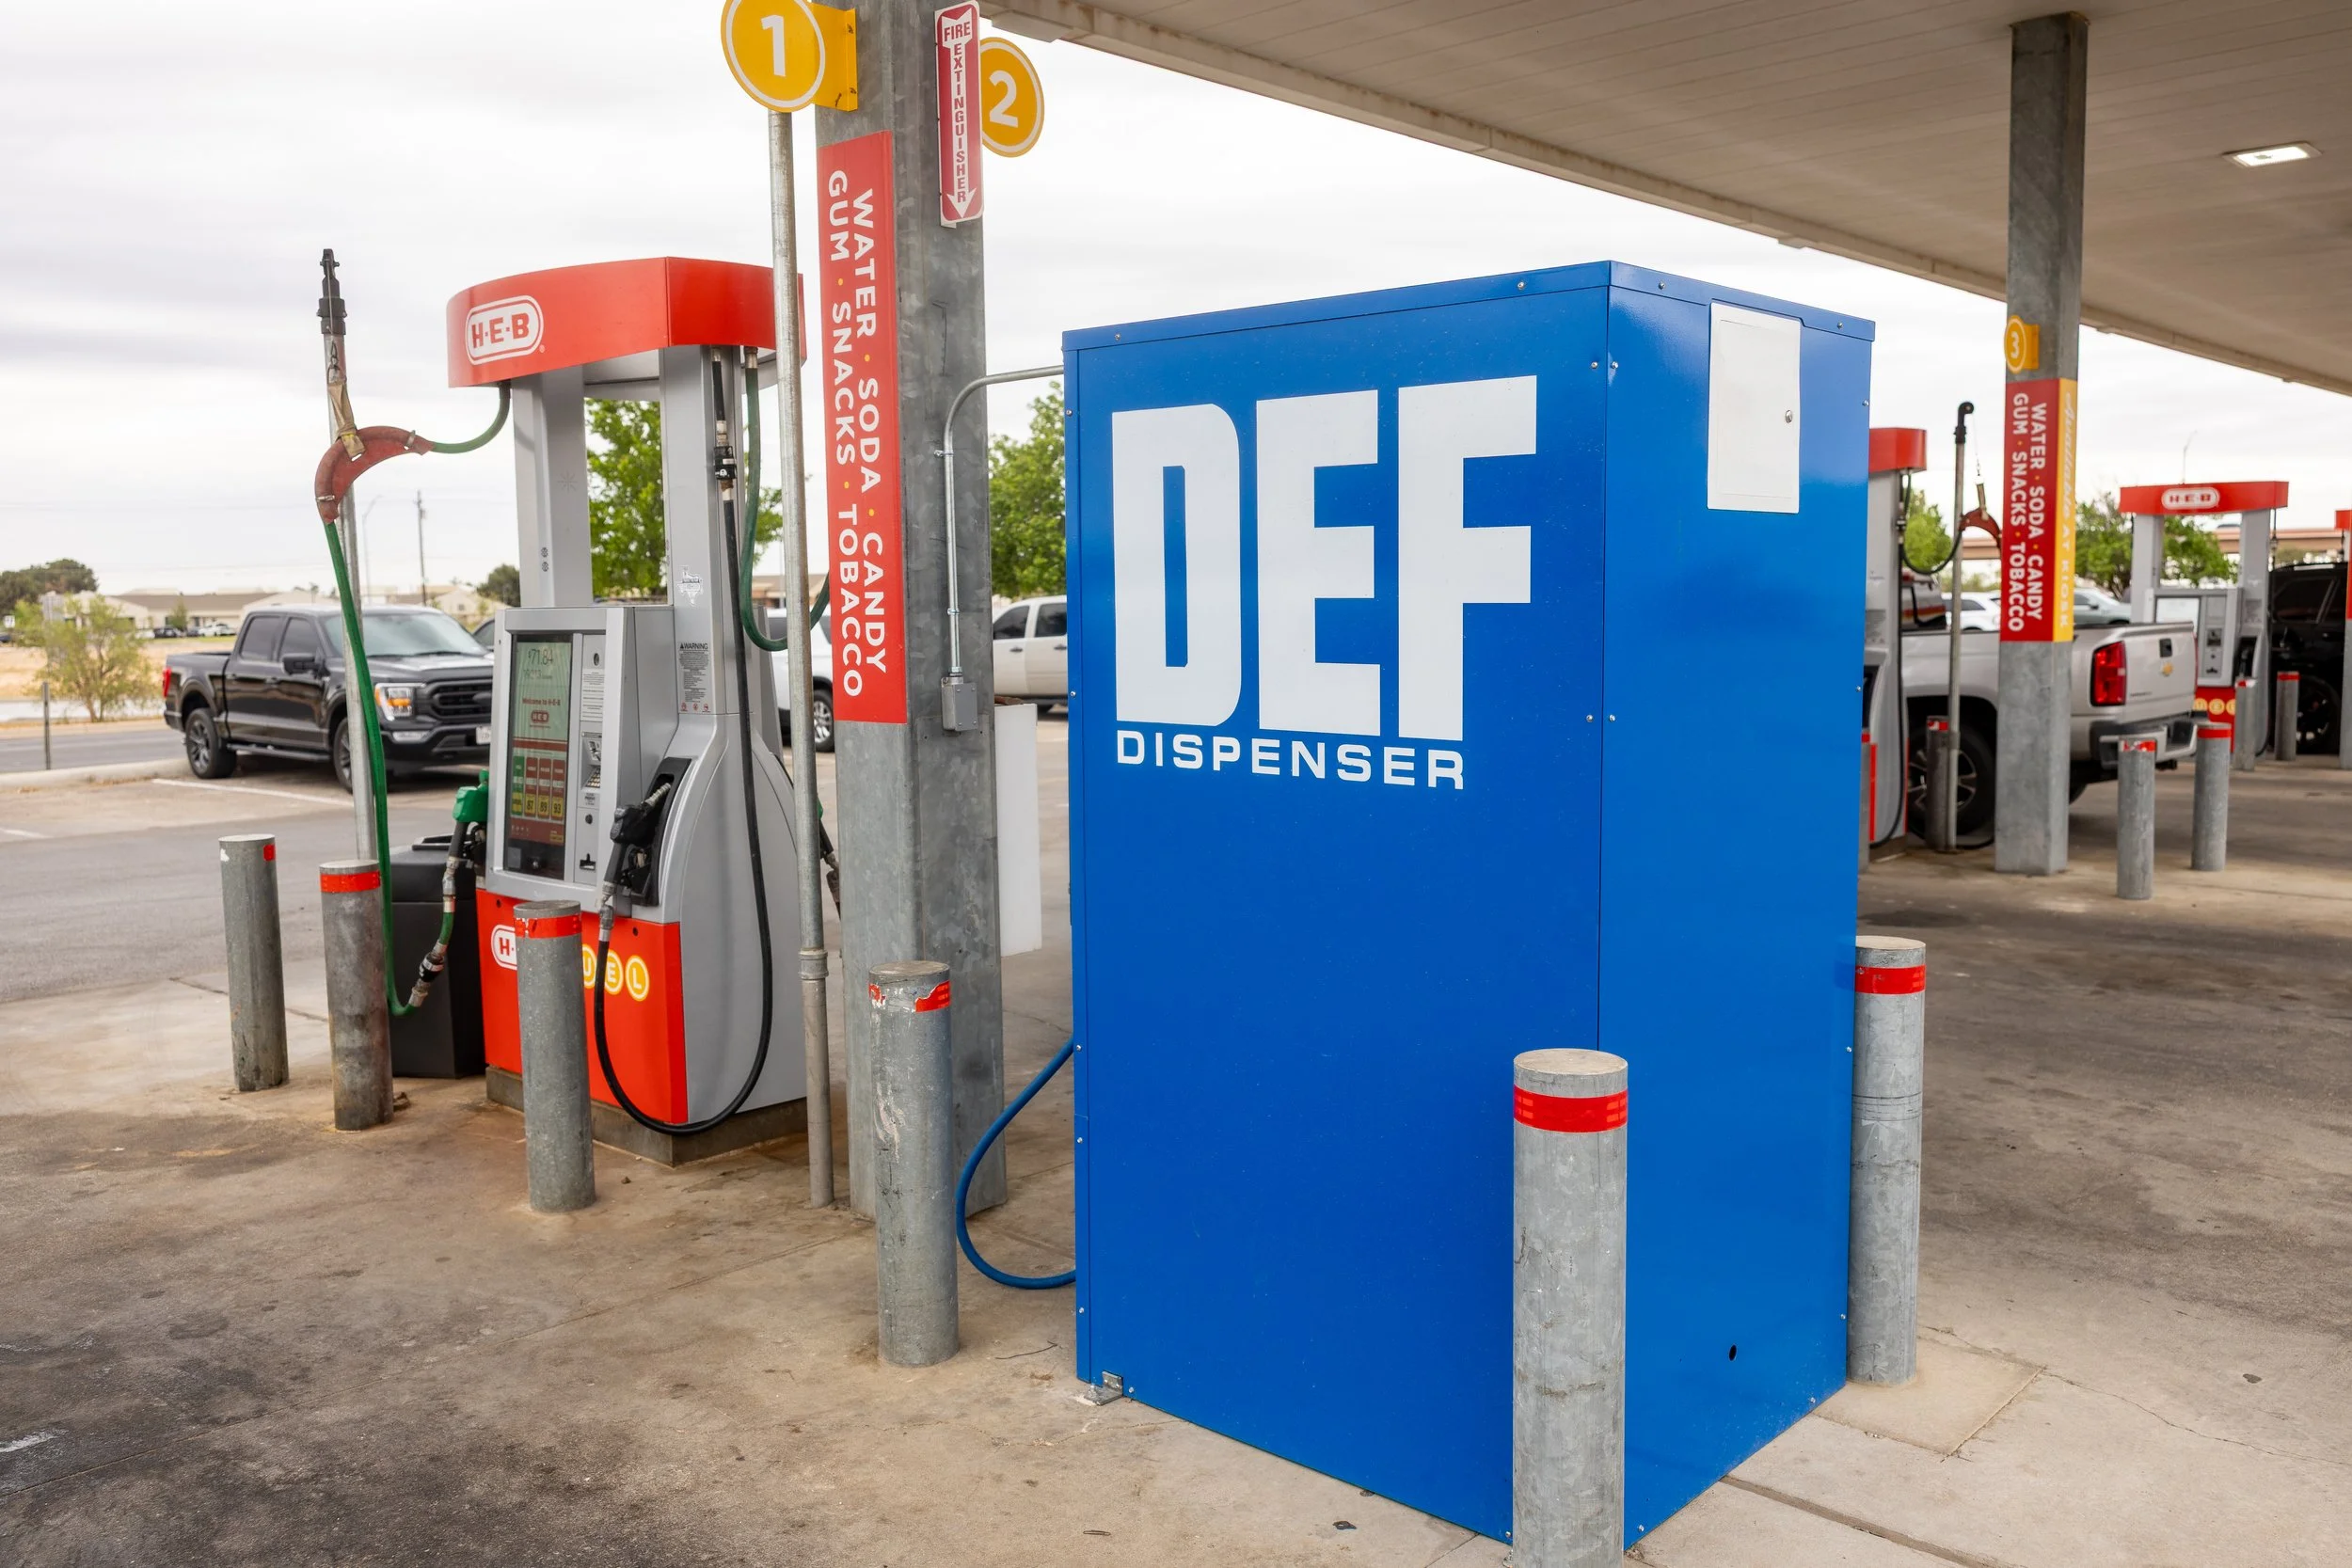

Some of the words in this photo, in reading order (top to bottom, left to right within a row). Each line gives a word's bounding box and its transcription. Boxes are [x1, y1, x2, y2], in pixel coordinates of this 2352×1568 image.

[760, 14, 786, 77] 1
[944, 22, 971, 42] FIRE
[953, 42, 967, 202] EXTINGUISHER
[989, 71, 1019, 128] 2
[828, 170, 850, 262] GUM
[853, 188, 877, 339] WATER
[2010, 331, 2020, 358] 3
[832, 302, 856, 466] SNACKS
[2012, 393, 2028, 436] GUM
[858, 377, 882, 493] SODA
[2030, 403, 2047, 469] WATER
[2010, 451, 2027, 527] SNACKS
[2028, 485, 2045, 539] SODA
[1112, 375, 1537, 741] DEF
[2008, 542, 2026, 632] TOBACCO
[2026, 554, 2043, 621] CANDY
[837, 503, 863, 697] TOBACCO
[863, 532, 886, 673] CANDY
[1117, 730, 1464, 790] DISPENSER
